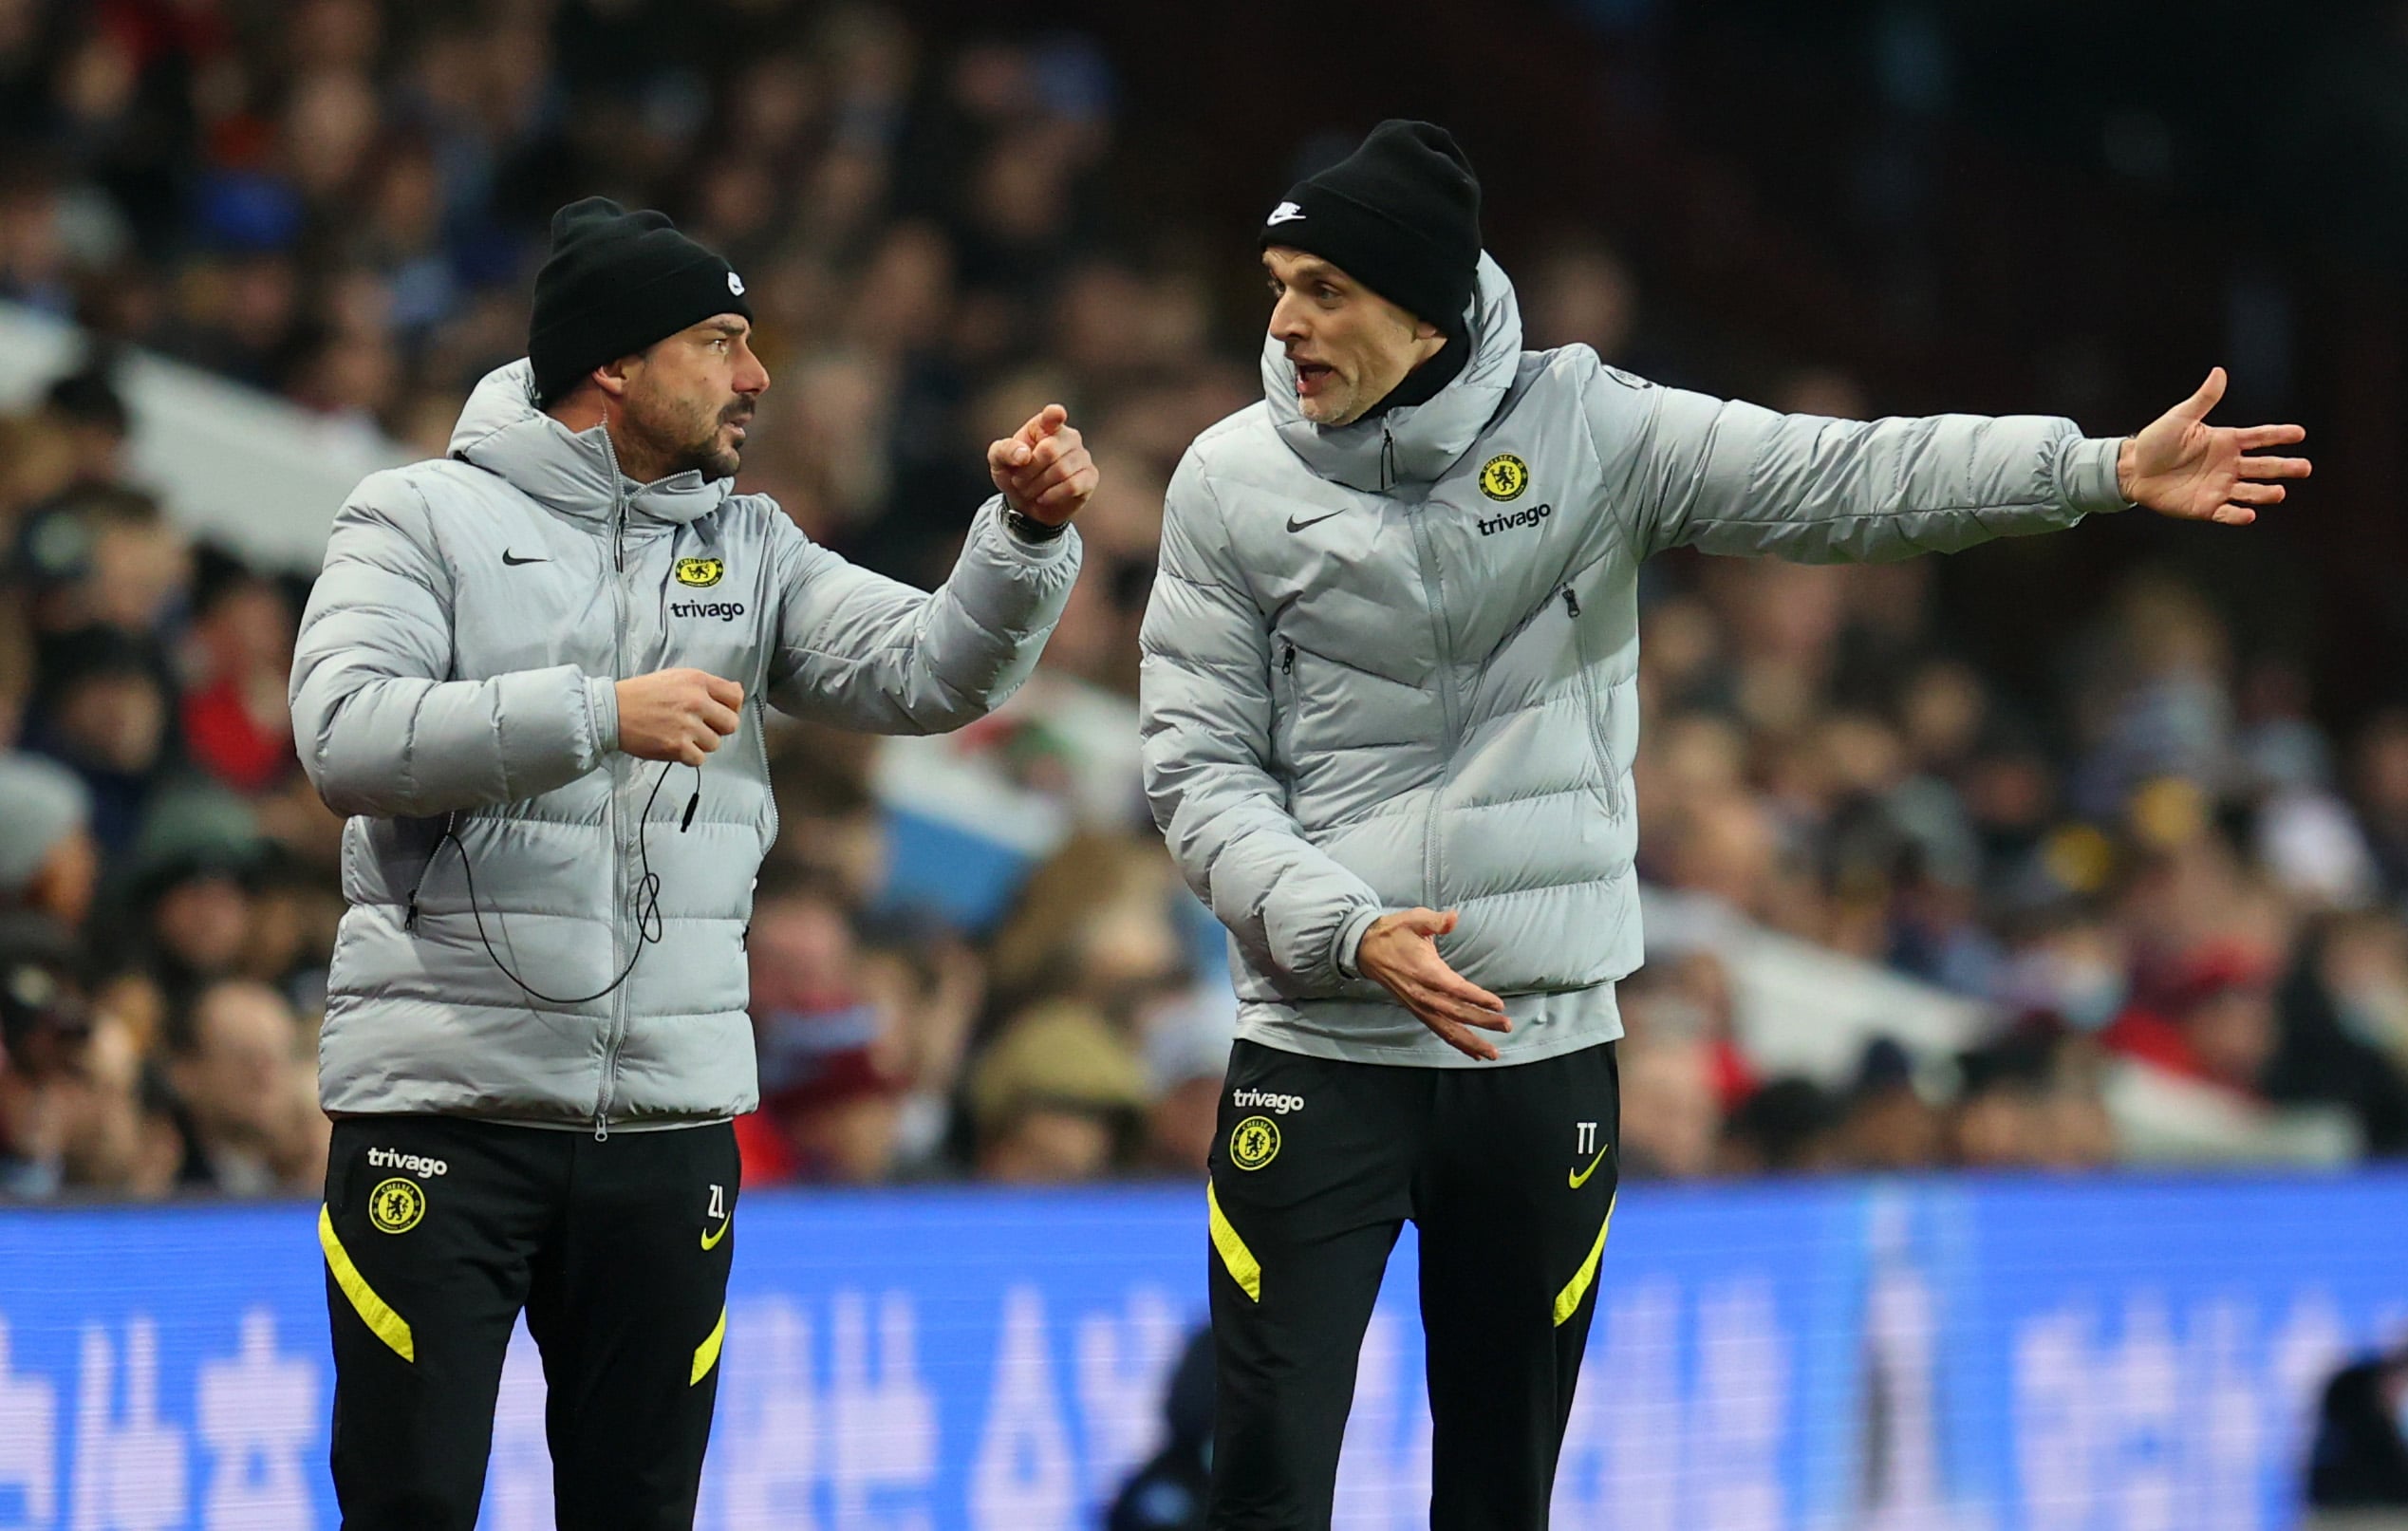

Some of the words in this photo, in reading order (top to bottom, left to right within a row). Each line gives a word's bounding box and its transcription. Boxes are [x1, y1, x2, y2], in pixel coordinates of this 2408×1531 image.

[1476, 503, 1552, 537] trivago
[670, 599, 745, 623] trivago
[1233, 1088, 1305, 1115] trivago
[1577, 1122, 1597, 1154] TT
[367, 1147, 448, 1179] trivago
[381, 1183, 416, 1196] CHELSEA
[707, 1184, 725, 1220] ZL
